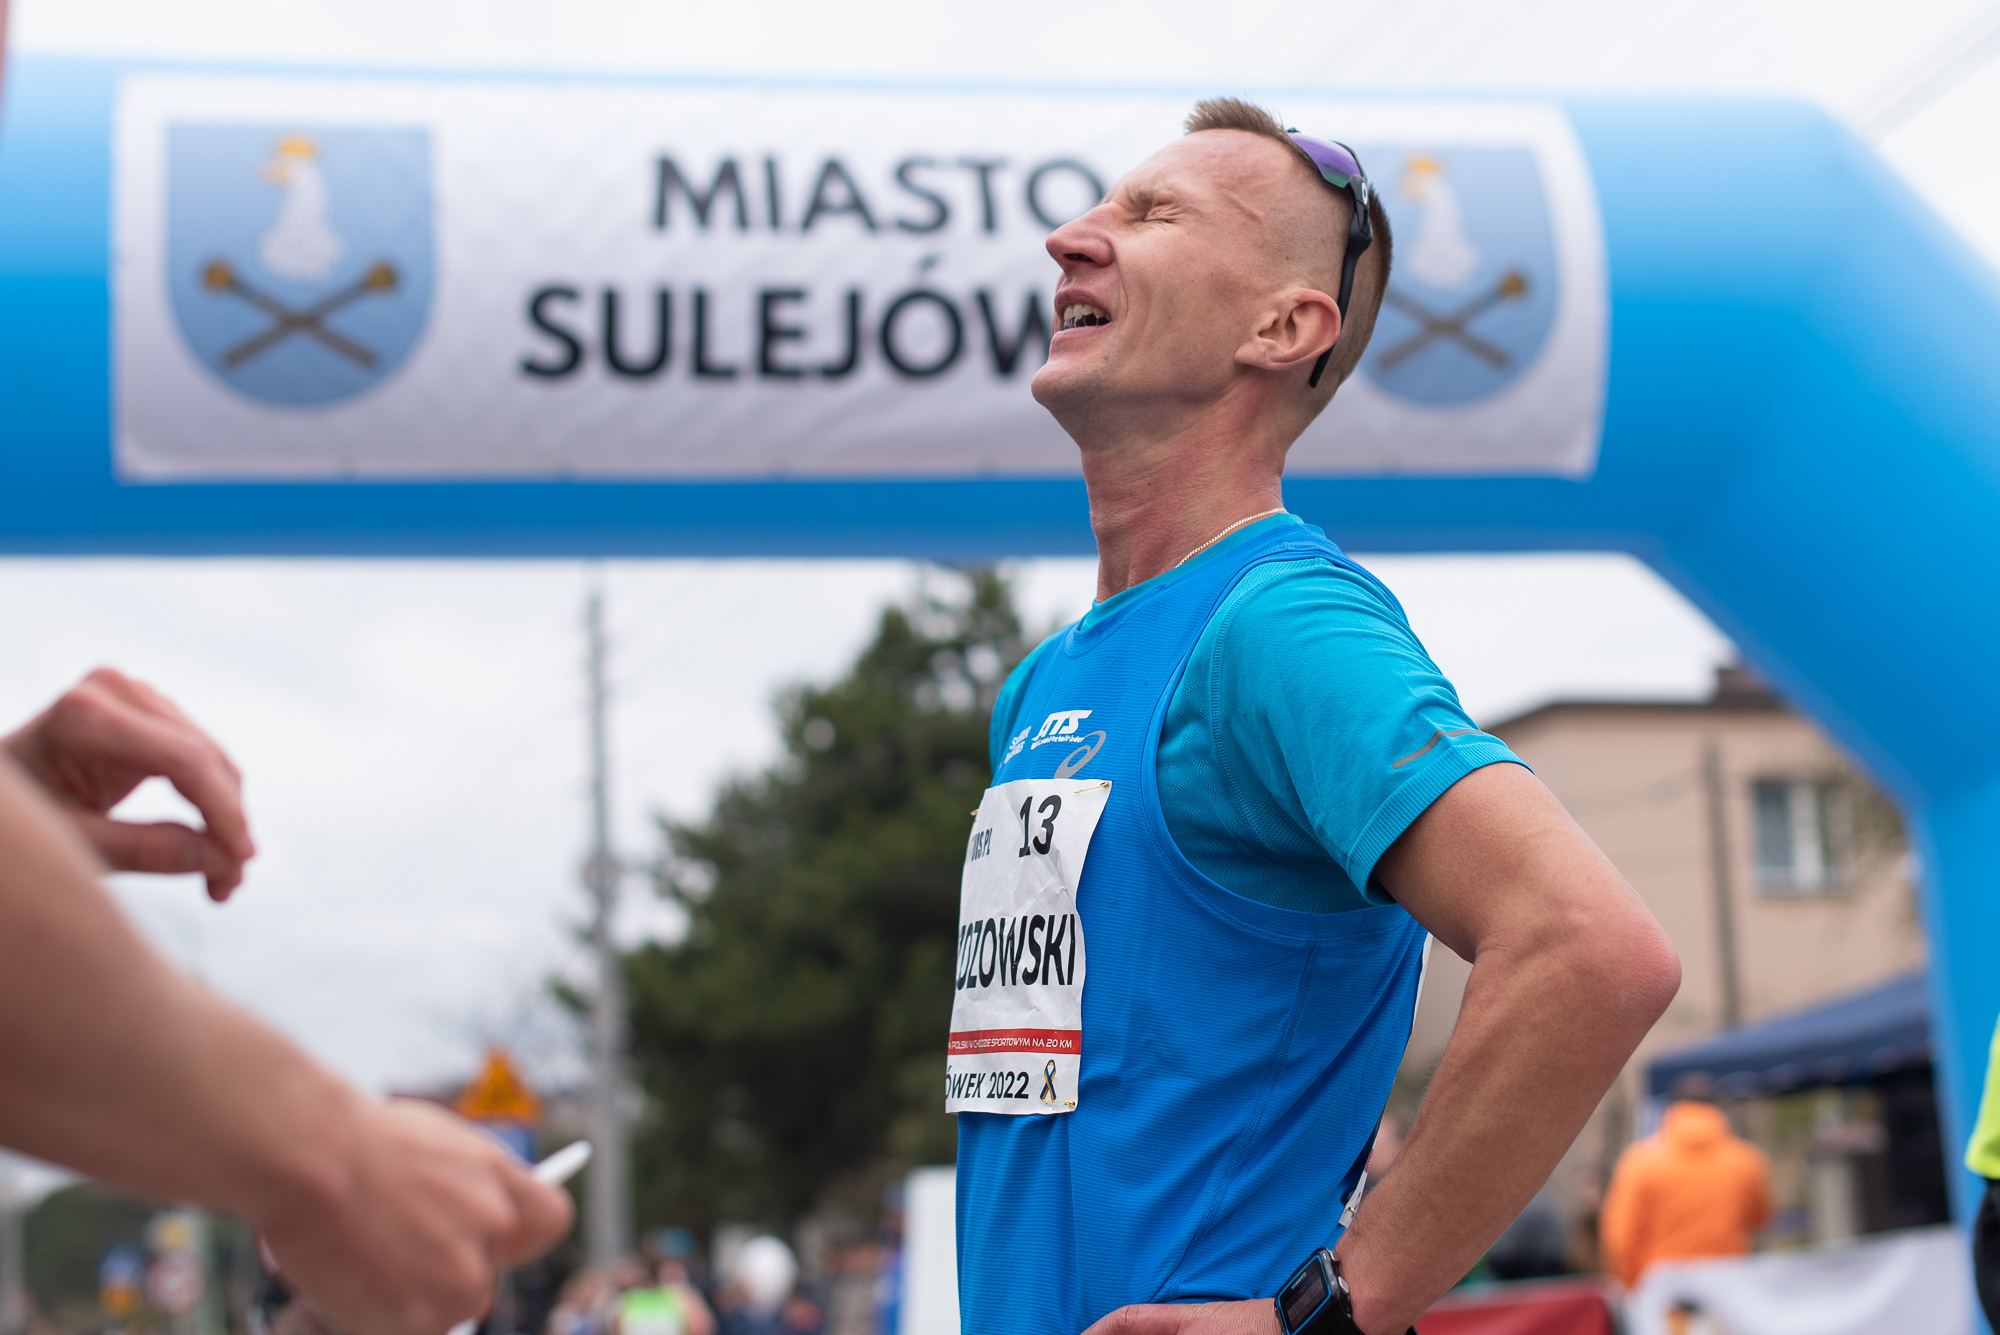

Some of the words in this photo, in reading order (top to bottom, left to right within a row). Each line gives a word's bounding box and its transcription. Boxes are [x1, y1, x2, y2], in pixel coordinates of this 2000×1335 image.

[650, 152, 1107, 235] MIASTO
[1019, 794, 1062, 858] 13
[991, 1037, 1031, 1047] SPORTOWYM
[1032, 1038, 1045, 1047] NA
[1046, 1038, 1059, 1048] 20
[1059, 1039, 1073, 1048] KM
[986, 1070, 1030, 1100] 2022
